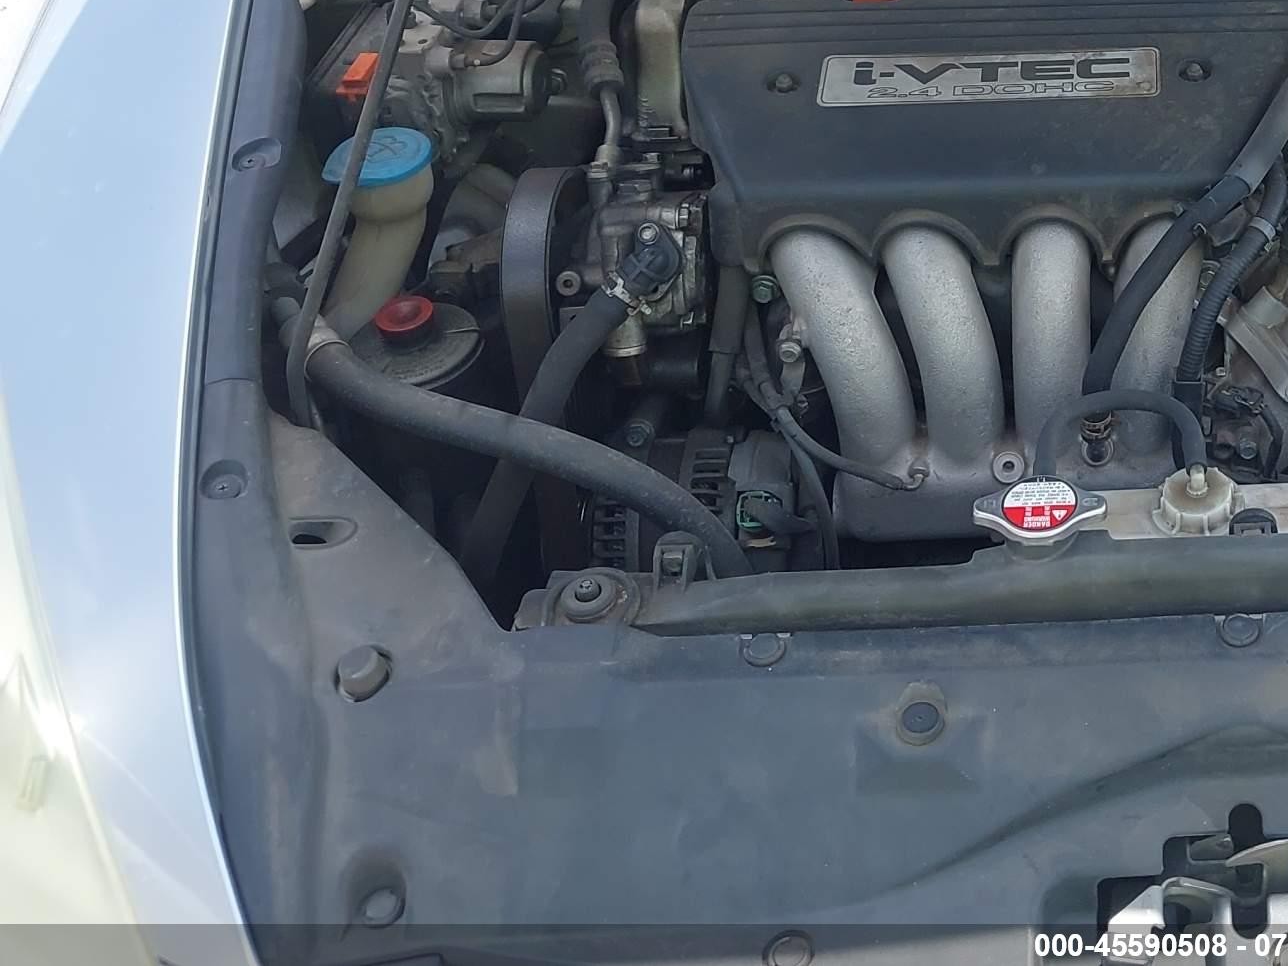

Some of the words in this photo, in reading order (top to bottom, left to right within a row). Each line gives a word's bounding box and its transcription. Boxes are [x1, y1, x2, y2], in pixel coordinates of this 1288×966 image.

[853, 58, 1130, 85] i-VTEC
[867, 85, 942, 99] 2.4
[952, 80, 1114, 97] DOHC
